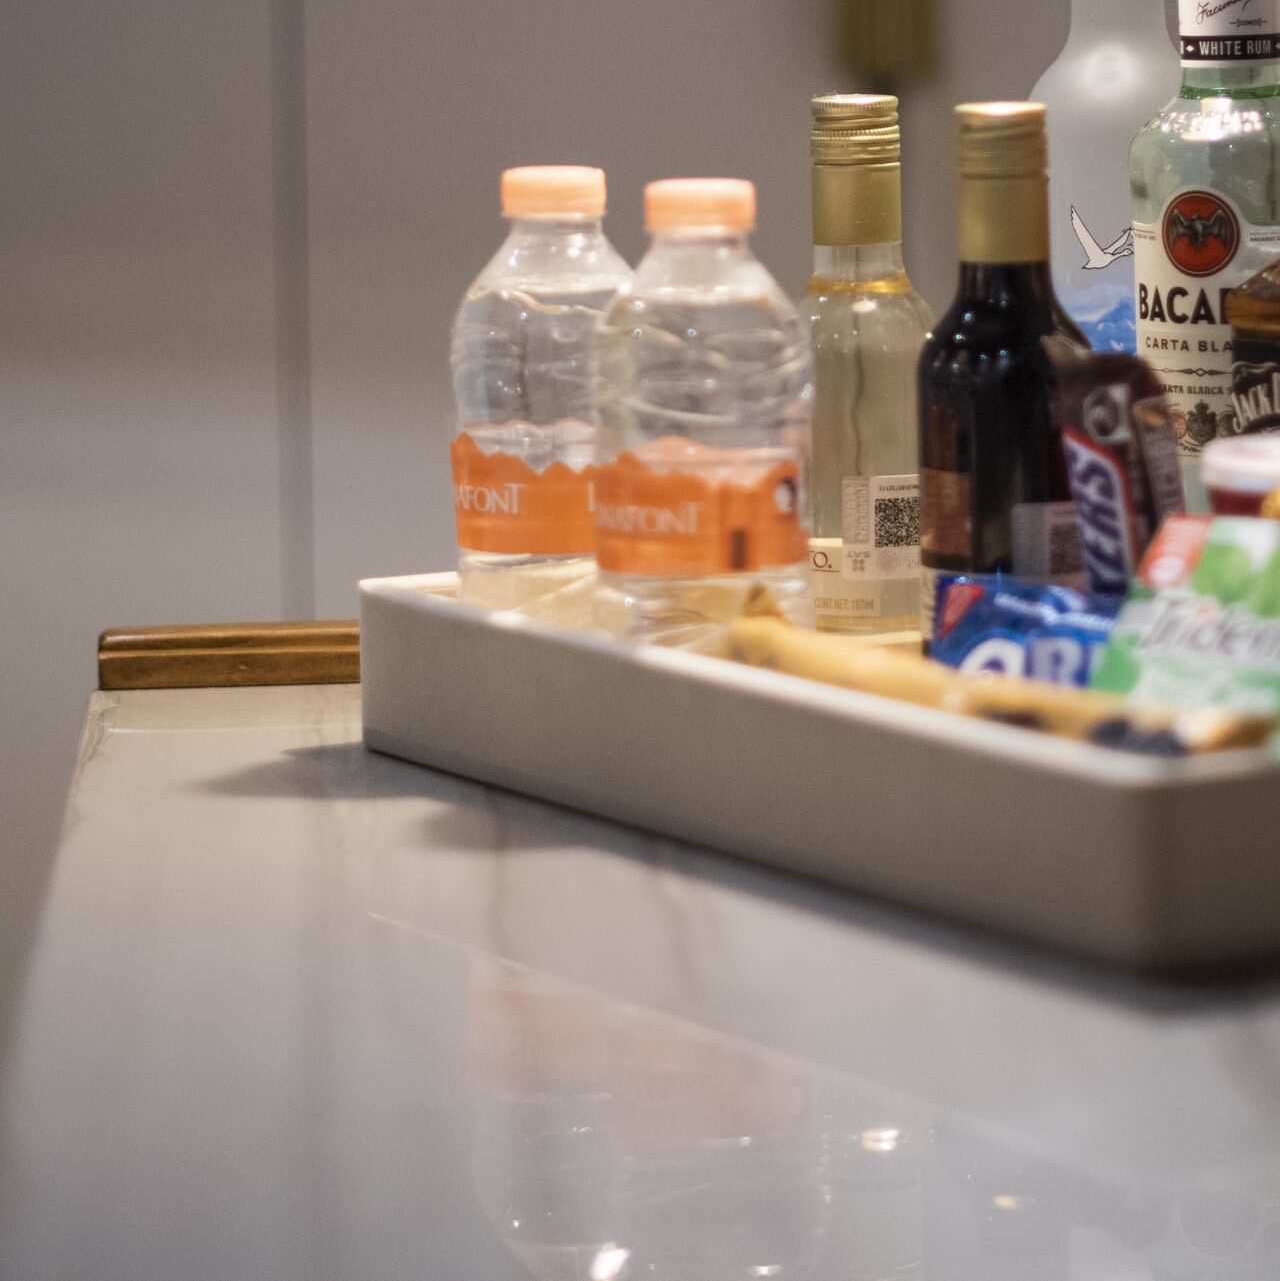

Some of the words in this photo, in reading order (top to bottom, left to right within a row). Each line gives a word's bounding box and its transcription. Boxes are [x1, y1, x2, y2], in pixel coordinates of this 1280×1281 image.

[1199, 40, 1242, 56] WHITE
[1246, 40, 1272, 55] RUM
[1145, 336, 1190, 352] CARTA
[1197, 340, 1233, 353] BLA
[1162, 385, 1184, 394] ARTA
[1232, 382, 1272, 433] JACK
